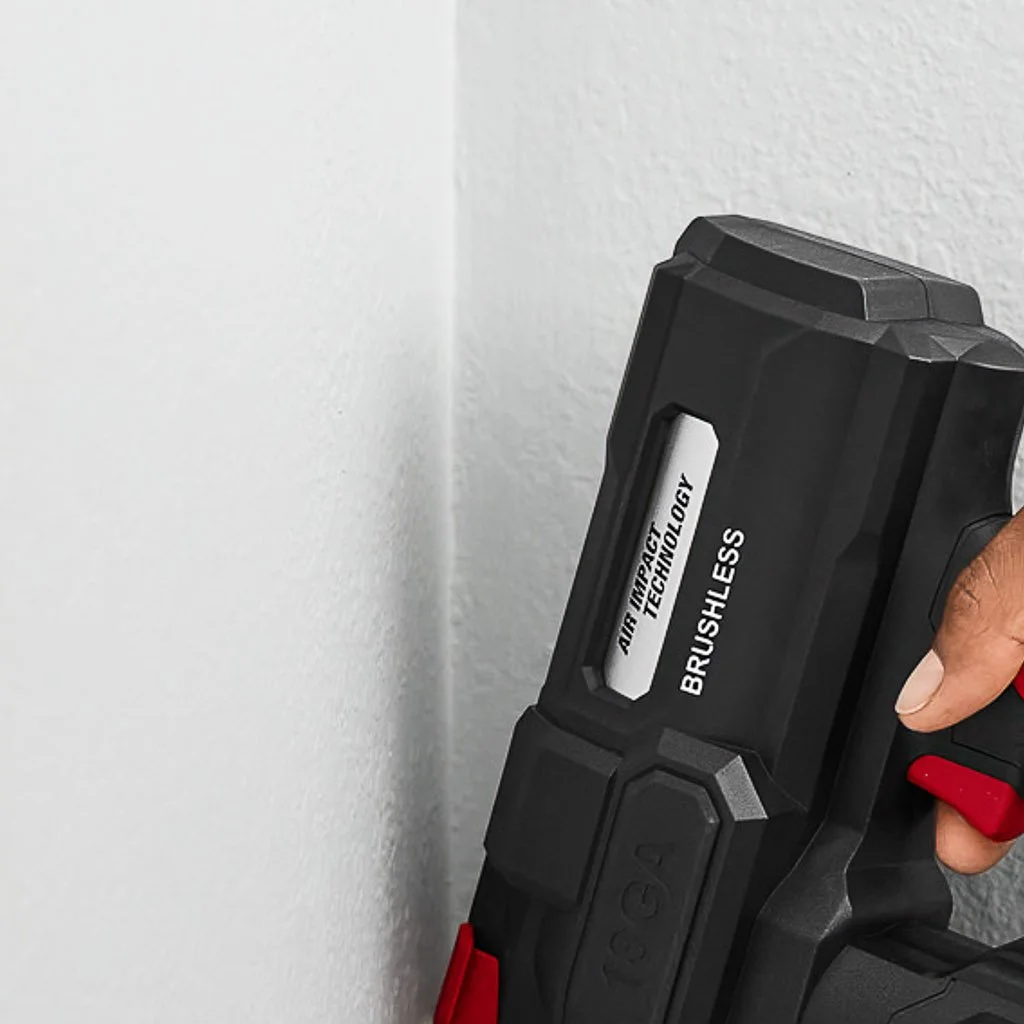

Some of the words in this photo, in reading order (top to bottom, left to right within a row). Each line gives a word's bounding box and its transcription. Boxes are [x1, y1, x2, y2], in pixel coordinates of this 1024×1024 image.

[618, 612, 637, 655] AIR
[629, 522, 661, 612] IMPACT
[643, 473, 693, 620] TECHNOLOGY
[680, 527, 745, 695] BRUSHLESS
